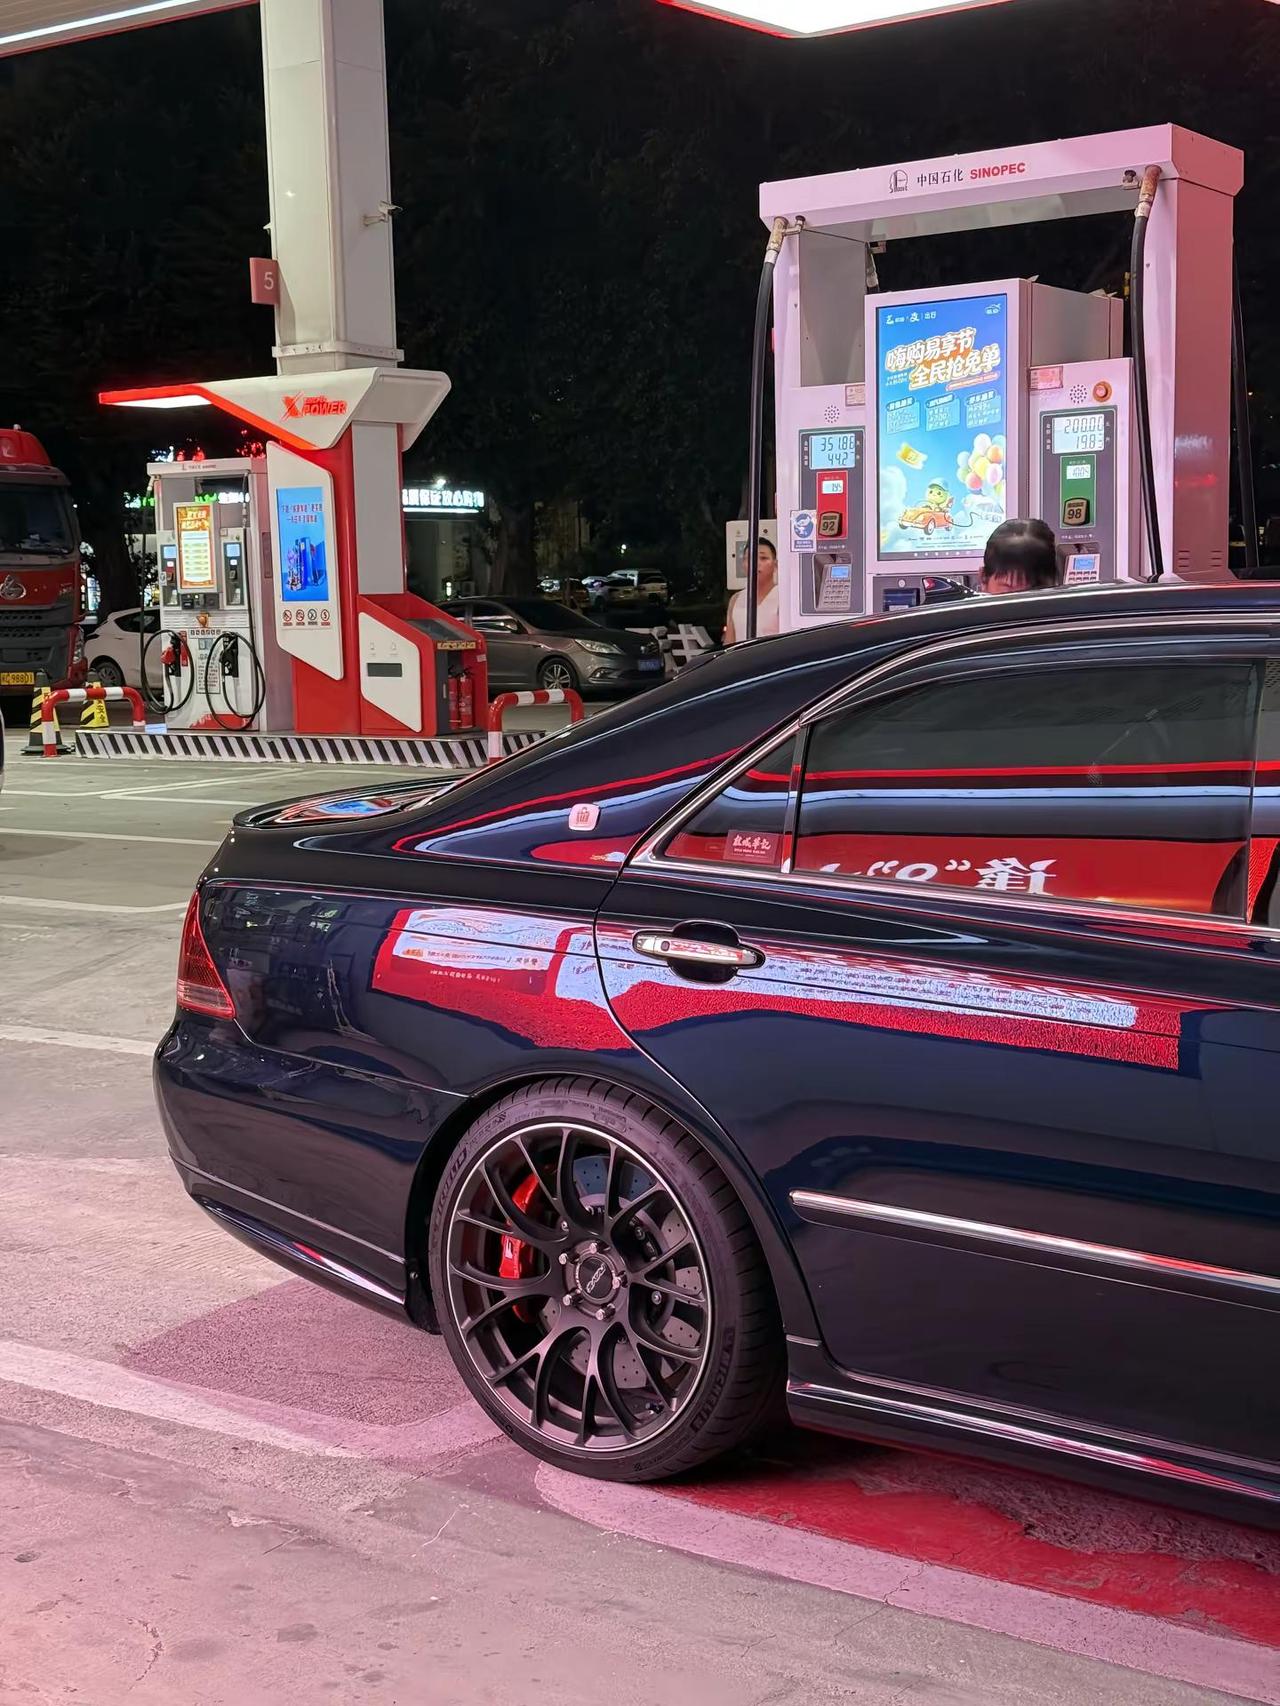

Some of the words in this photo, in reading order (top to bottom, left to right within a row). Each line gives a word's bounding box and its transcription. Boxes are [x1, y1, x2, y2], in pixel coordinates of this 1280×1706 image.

[917, 168, 964, 187] 中国石化
[970, 162, 1026, 180] SINOPEC
[264, 271, 274, 290] 5
[909, 345, 1000, 388] 全民抢免单
[1067, 508, 1082, 520] 98
[822, 521, 835, 532] 92
